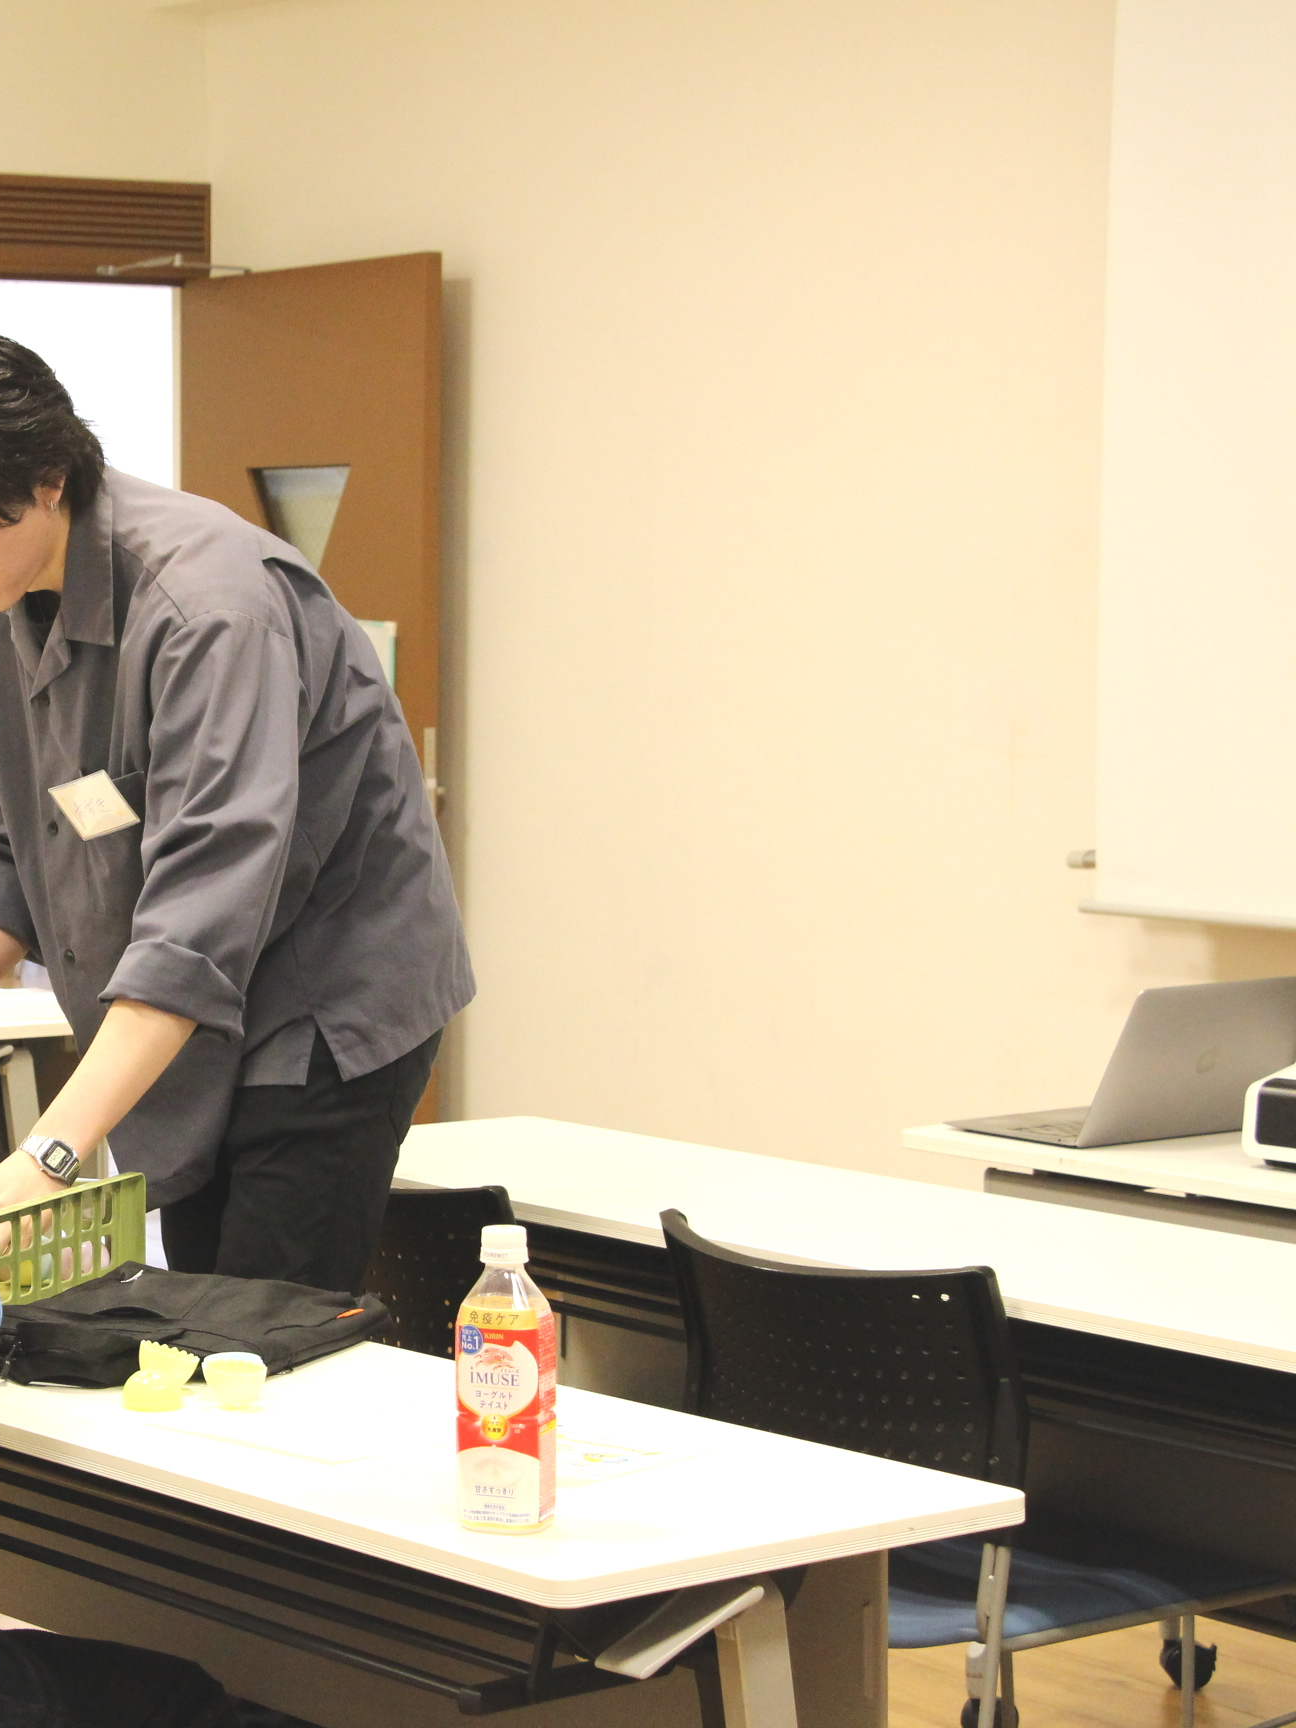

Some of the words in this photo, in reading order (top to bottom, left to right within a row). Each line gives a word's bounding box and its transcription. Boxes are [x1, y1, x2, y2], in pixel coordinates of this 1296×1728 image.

[469, 1310, 519, 1325] 免疫ケア
[484, 1332, 504, 1340] KIRIN
[475, 1390, 513, 1400] ヨーグルト
[479, 1400, 509, 1410] テイスト
[474, 1485, 514, 1496] 甘さすっきり
